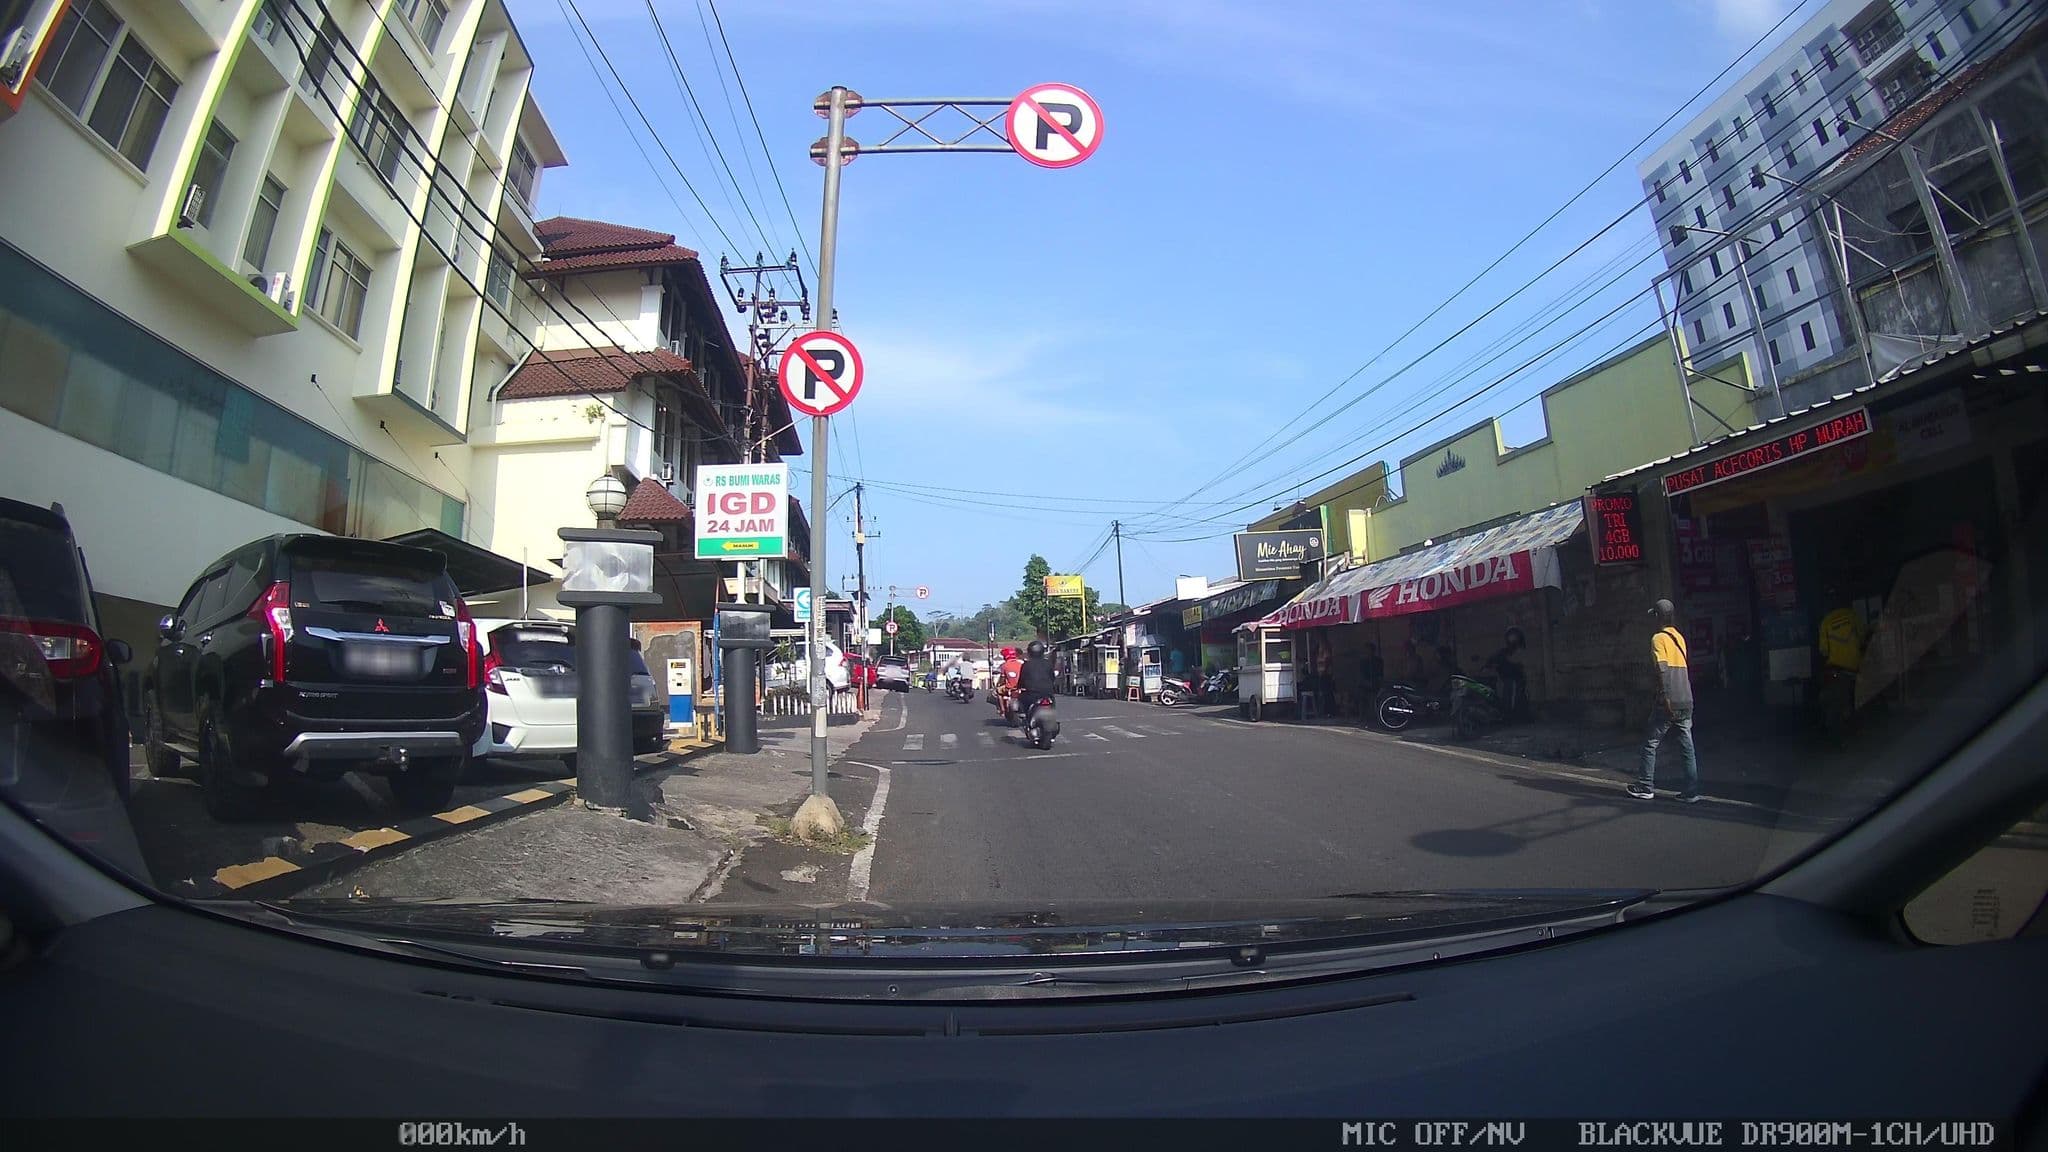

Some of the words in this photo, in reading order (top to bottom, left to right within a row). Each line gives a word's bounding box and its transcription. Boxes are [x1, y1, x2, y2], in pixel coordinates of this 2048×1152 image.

[1035, 102, 1083, 150] P
[803, 349, 846, 399] P
[1666, 467, 1706, 493] PUSAT
[1788, 433, 1808, 454] HP
[1815, 412, 1866, 444] MURAH
[715, 475, 727, 487] RS
[728, 474, 750, 486] BUMI
[751, 473, 781, 485] WARAS
[707, 491, 776, 516] IGD
[1591, 498, 1633, 511] PROMO
[707, 519, 730, 533] 24
[734, 518, 775, 533] JAM
[1603, 512, 1627, 528] TRI
[1606, 528, 1631, 544] 4GB
[1257, 541, 1278, 558] Mie
[1600, 544, 1640, 561] 10.000
[1395, 554, 1519, 605] HONDA
[1276, 597, 1341, 623] HONDA
